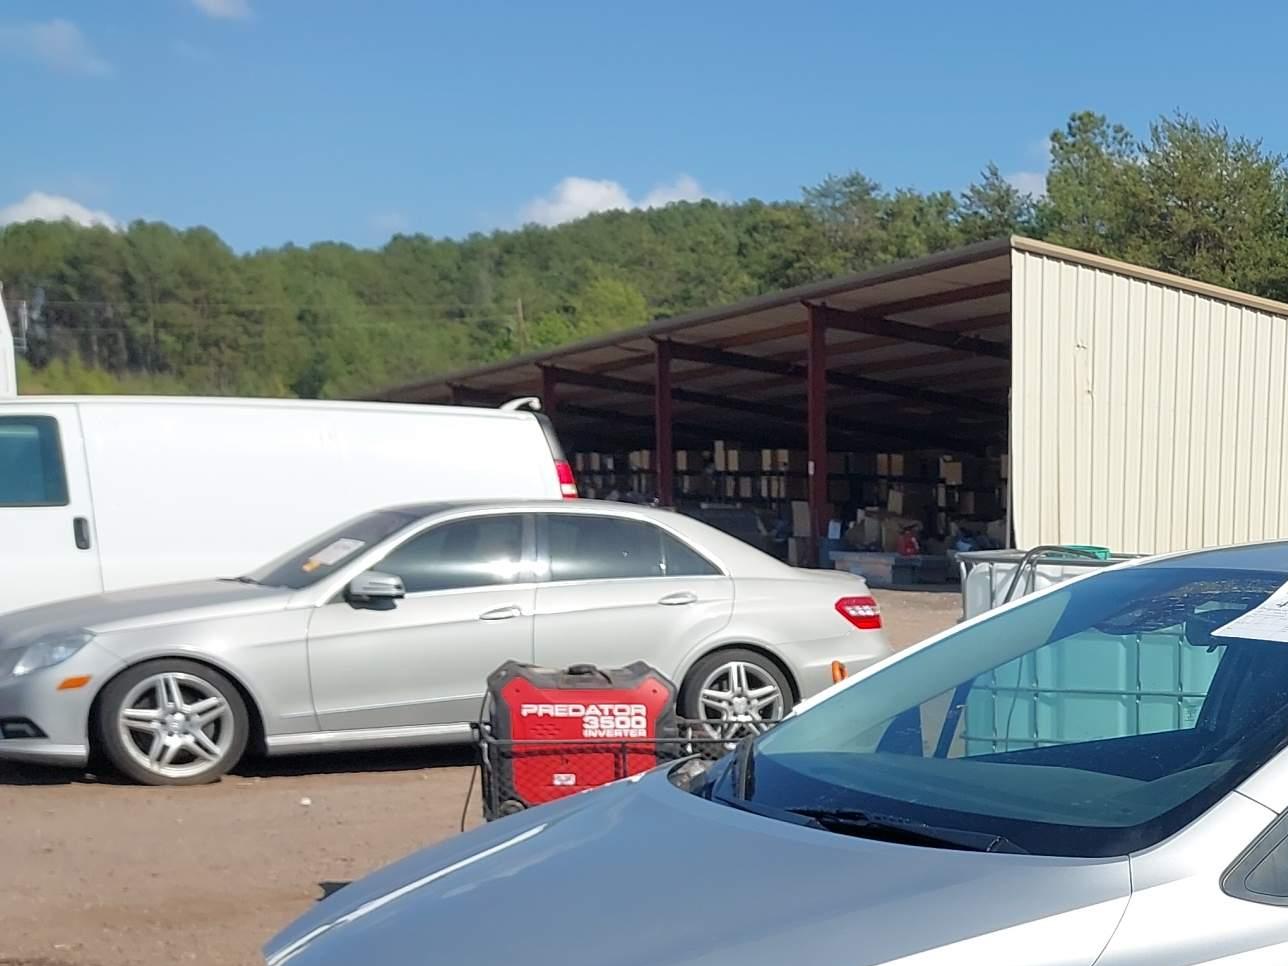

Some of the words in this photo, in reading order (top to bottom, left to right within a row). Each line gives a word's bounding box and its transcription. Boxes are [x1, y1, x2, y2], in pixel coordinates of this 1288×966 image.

[520, 704, 647, 717] PREDATOR
[582, 715, 647, 729] 3500
[582, 728, 647, 738] INVERTER
